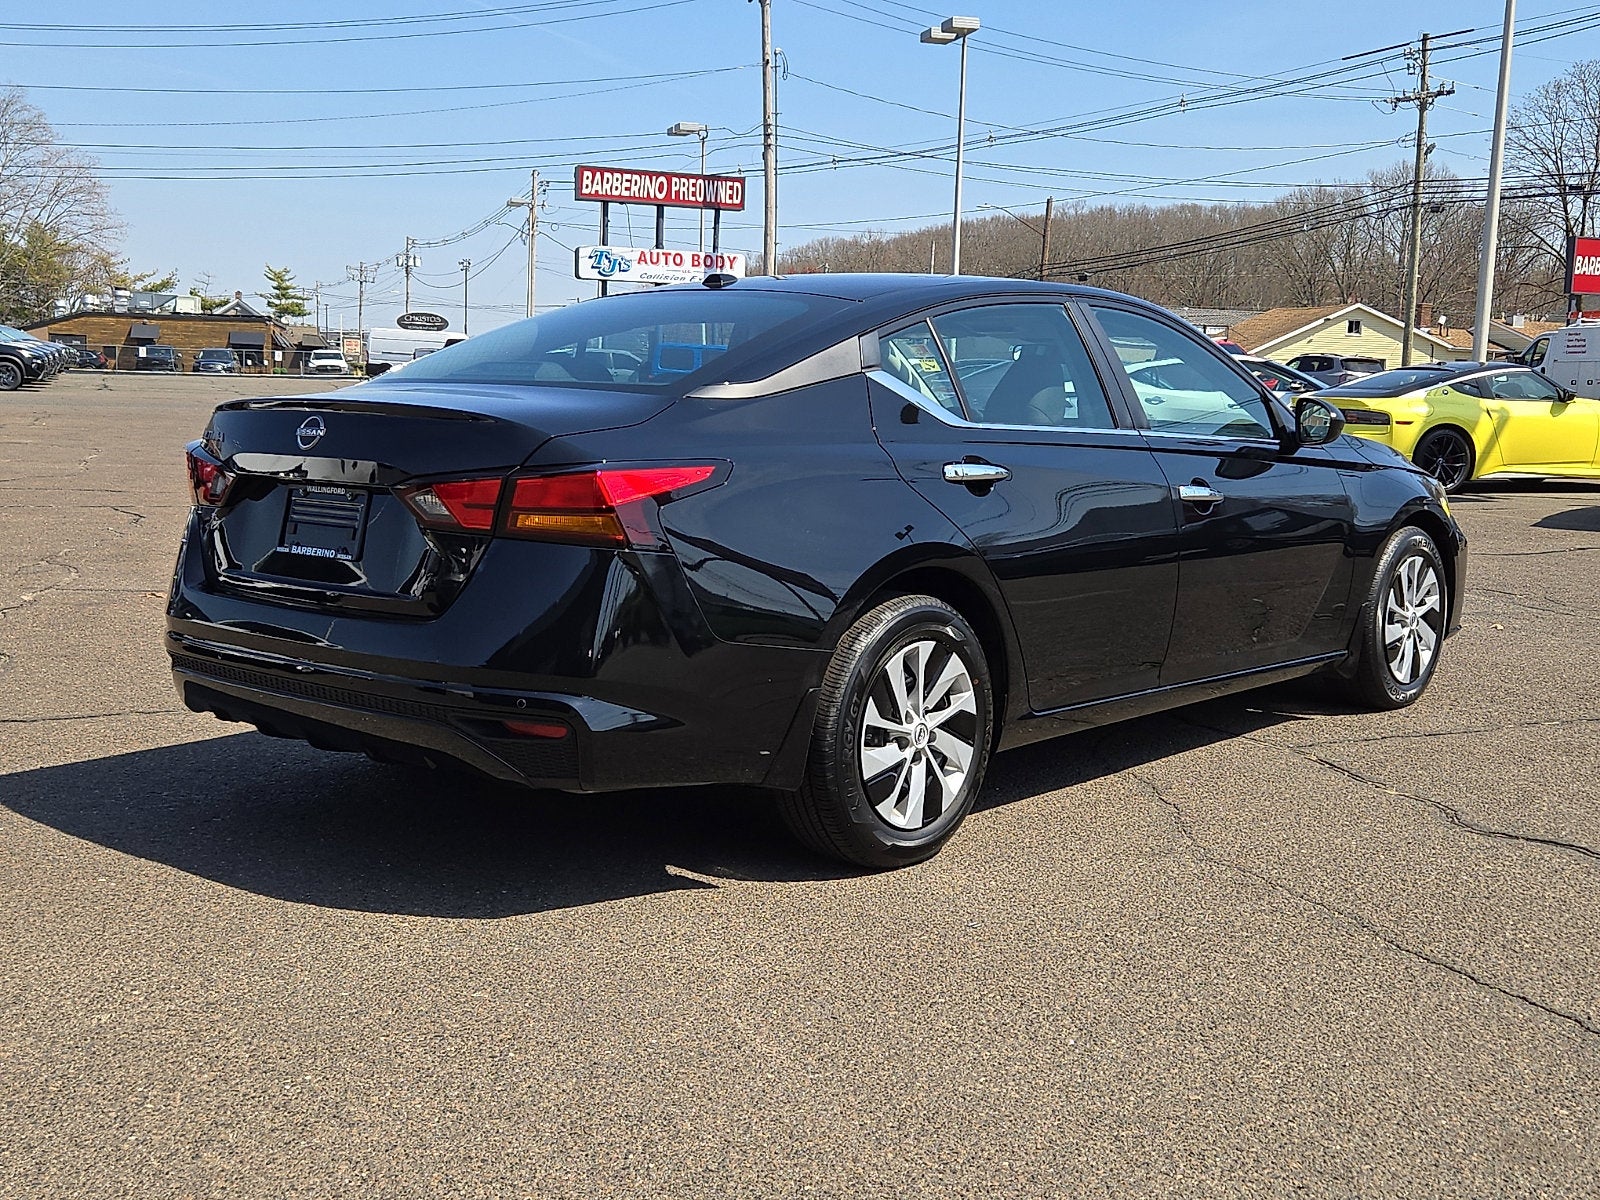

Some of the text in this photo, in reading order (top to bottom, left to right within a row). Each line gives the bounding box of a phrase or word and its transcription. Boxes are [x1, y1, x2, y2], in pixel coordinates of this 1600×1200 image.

[581, 170, 742, 204] BARBERINO PREOWNED
[637, 250, 684, 267] AUTO
[691, 254, 738, 271] BODY
[639, 272, 686, 282] Collision
[306, 485, 346, 495] WALLINGFORD
[291, 545, 336, 558] BARBERINO
